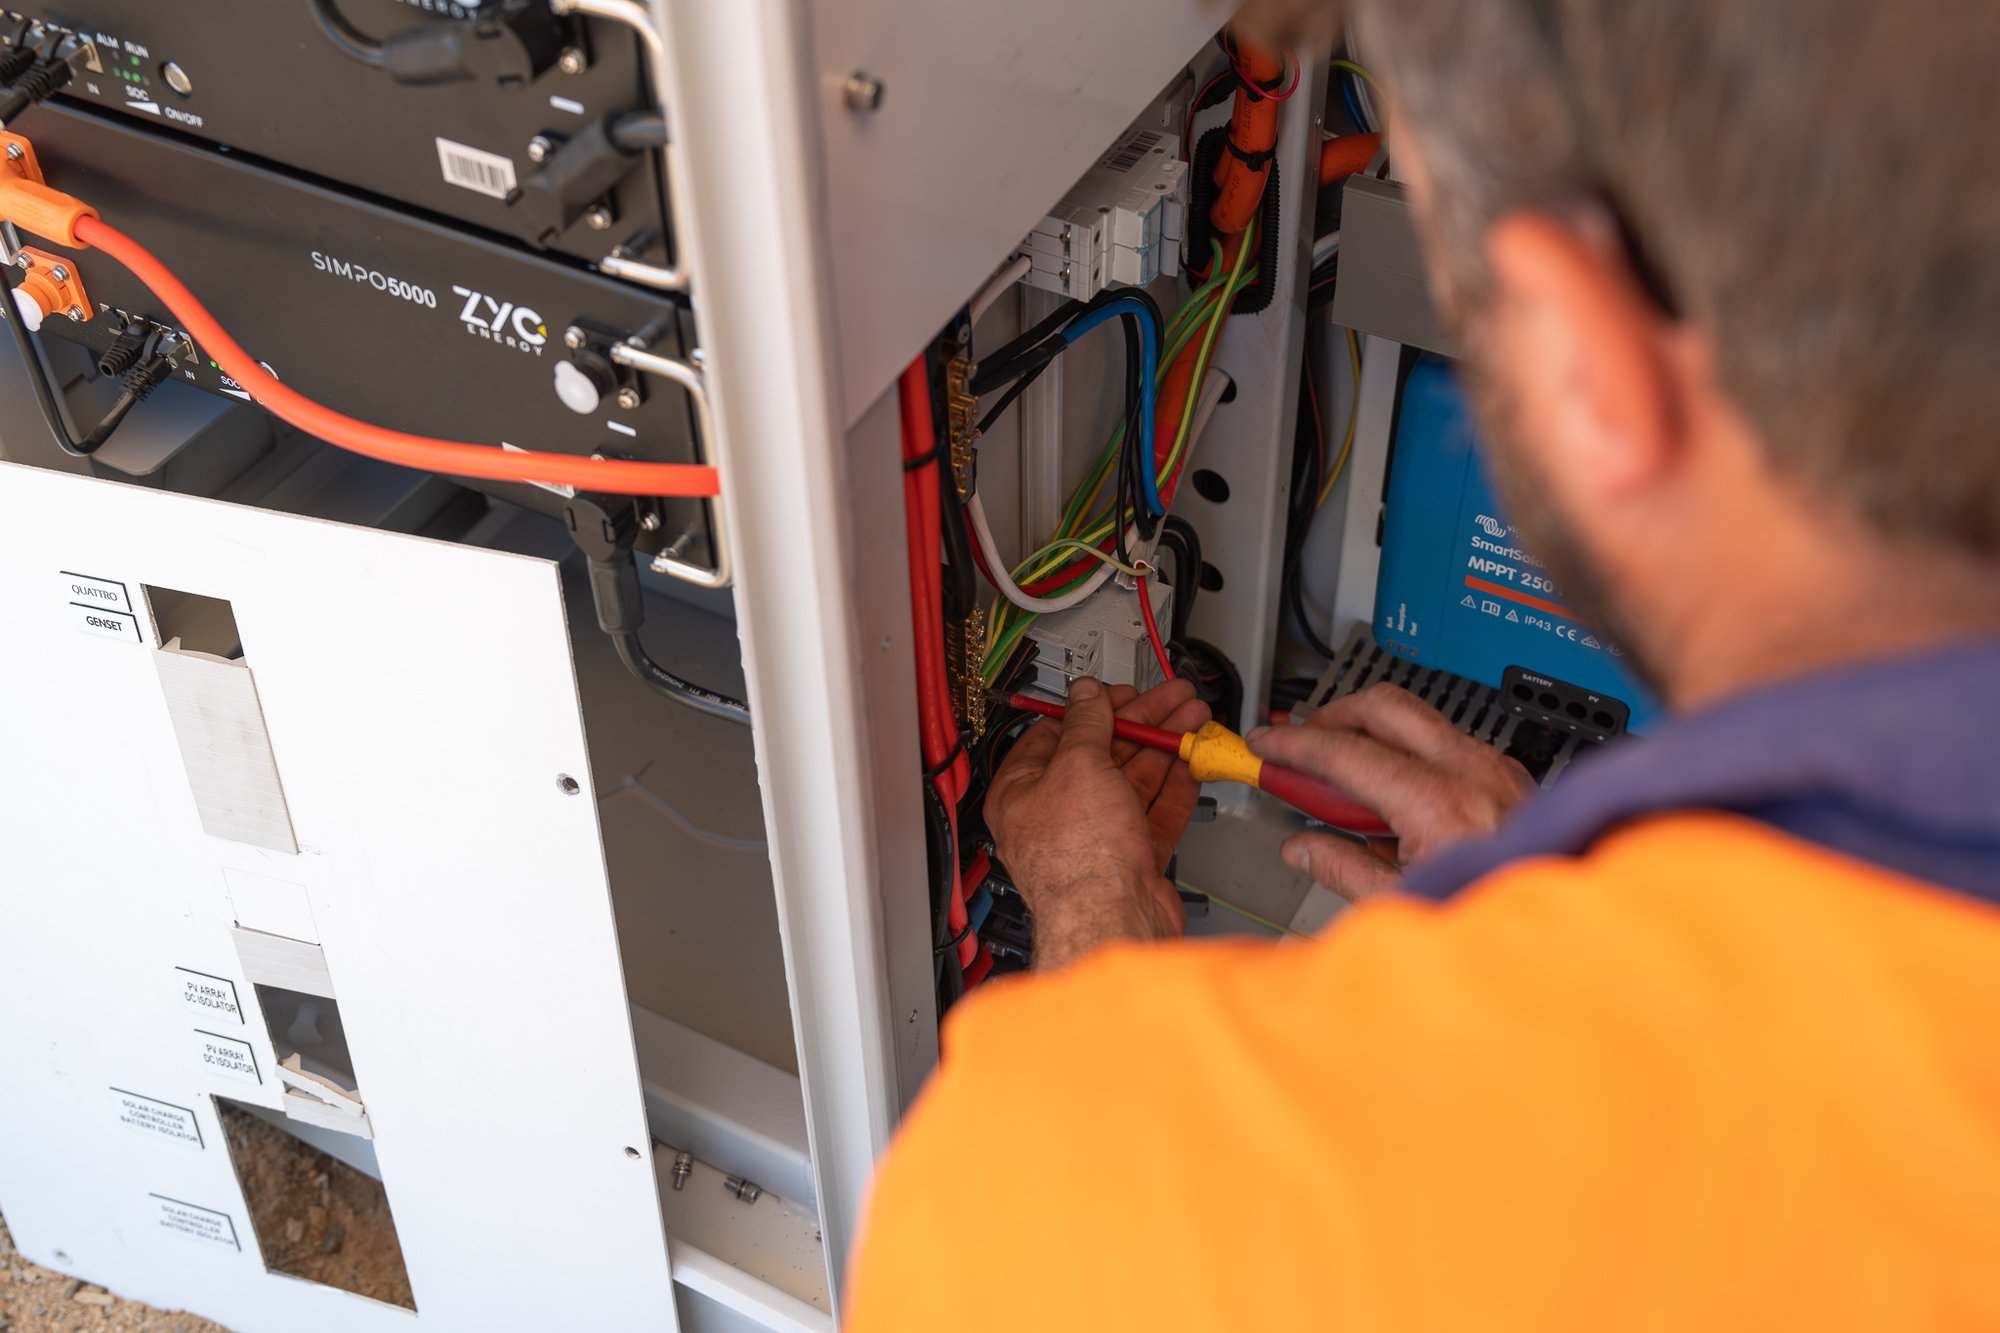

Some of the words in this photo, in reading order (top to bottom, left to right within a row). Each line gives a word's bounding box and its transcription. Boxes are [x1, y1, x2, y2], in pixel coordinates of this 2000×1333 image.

[96, 32, 119, 49] ALM
[124, 40, 149, 58] RUN
[87, 82, 100, 95] IN
[125, 84, 150, 101] SOC
[164, 106, 204, 128] ON/OFF
[311, 251, 437, 309] SIMPO5000
[452, 284, 547, 346] ZYC
[466, 323, 543, 356] ENERGY
[184, 369, 196, 381] IN
[220, 375, 241, 390] SOC
[1468, 555, 1517, 581] MPPT
[1520, 572, 1554, 594] 250
[71, 584, 118, 601] QUATTRO
[86, 616, 122, 631] GENSET
[1524, 615, 1552, 632] IP43
[1522, 673, 1553, 688] BATTERY
[1588, 695, 1599, 704] PV
[187, 981, 198, 993] PV
[201, 986, 226, 1001] ARRAY
[184, 991, 197, 1004] DC
[197, 995, 238, 1014] ISOLATOR
[206, 1043, 217, 1055] PV
[219, 1047, 244, 1062] ARRAY
[203, 1053, 216, 1066] DC
[217, 1057, 256, 1075] ISOLATOR
